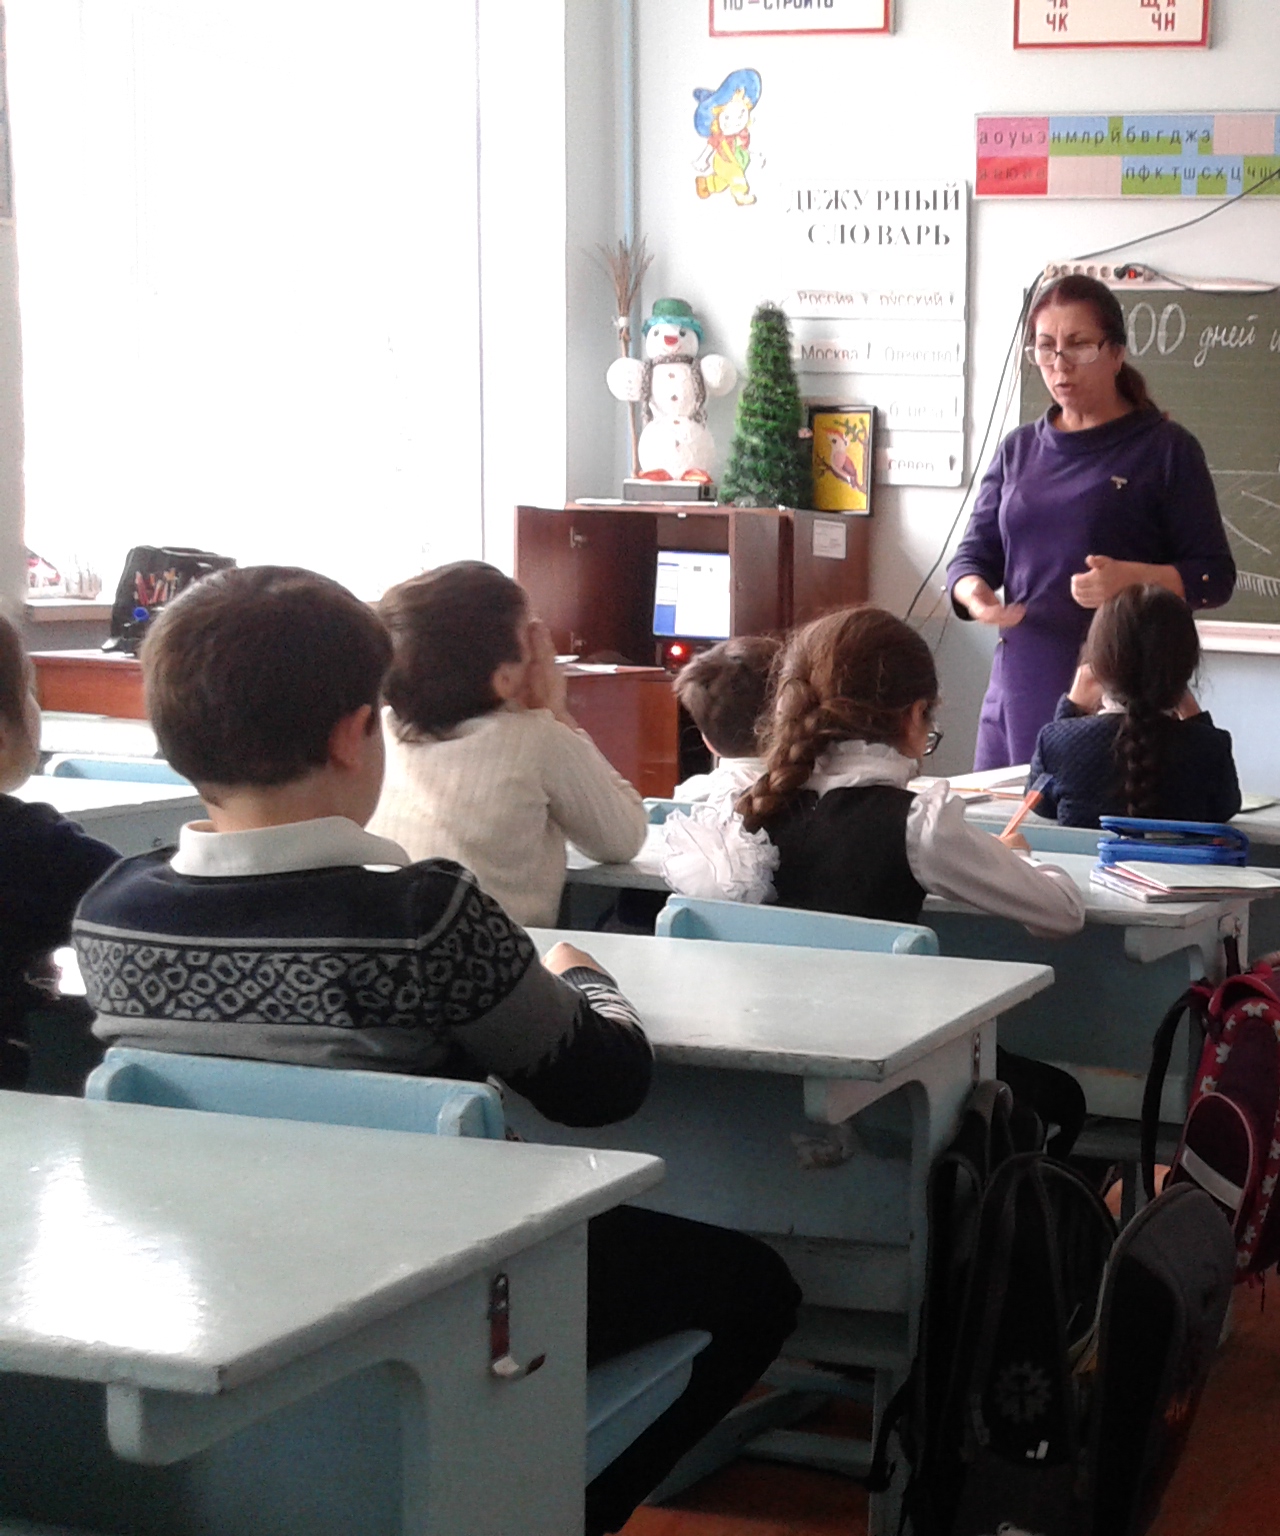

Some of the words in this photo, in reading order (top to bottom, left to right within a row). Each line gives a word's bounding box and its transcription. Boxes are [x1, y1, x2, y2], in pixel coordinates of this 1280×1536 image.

[1046, 12, 1068, 32] ЧК
[1151, 12, 1176, 31] ЧН
[785, 181, 960, 213] ДЕЖУРНЫЙ
[807, 224, 951, 246] СЛОВАРЬ
[1124, 301, 1186, 356] 00
[1194, 314, 1258, 367] дней
